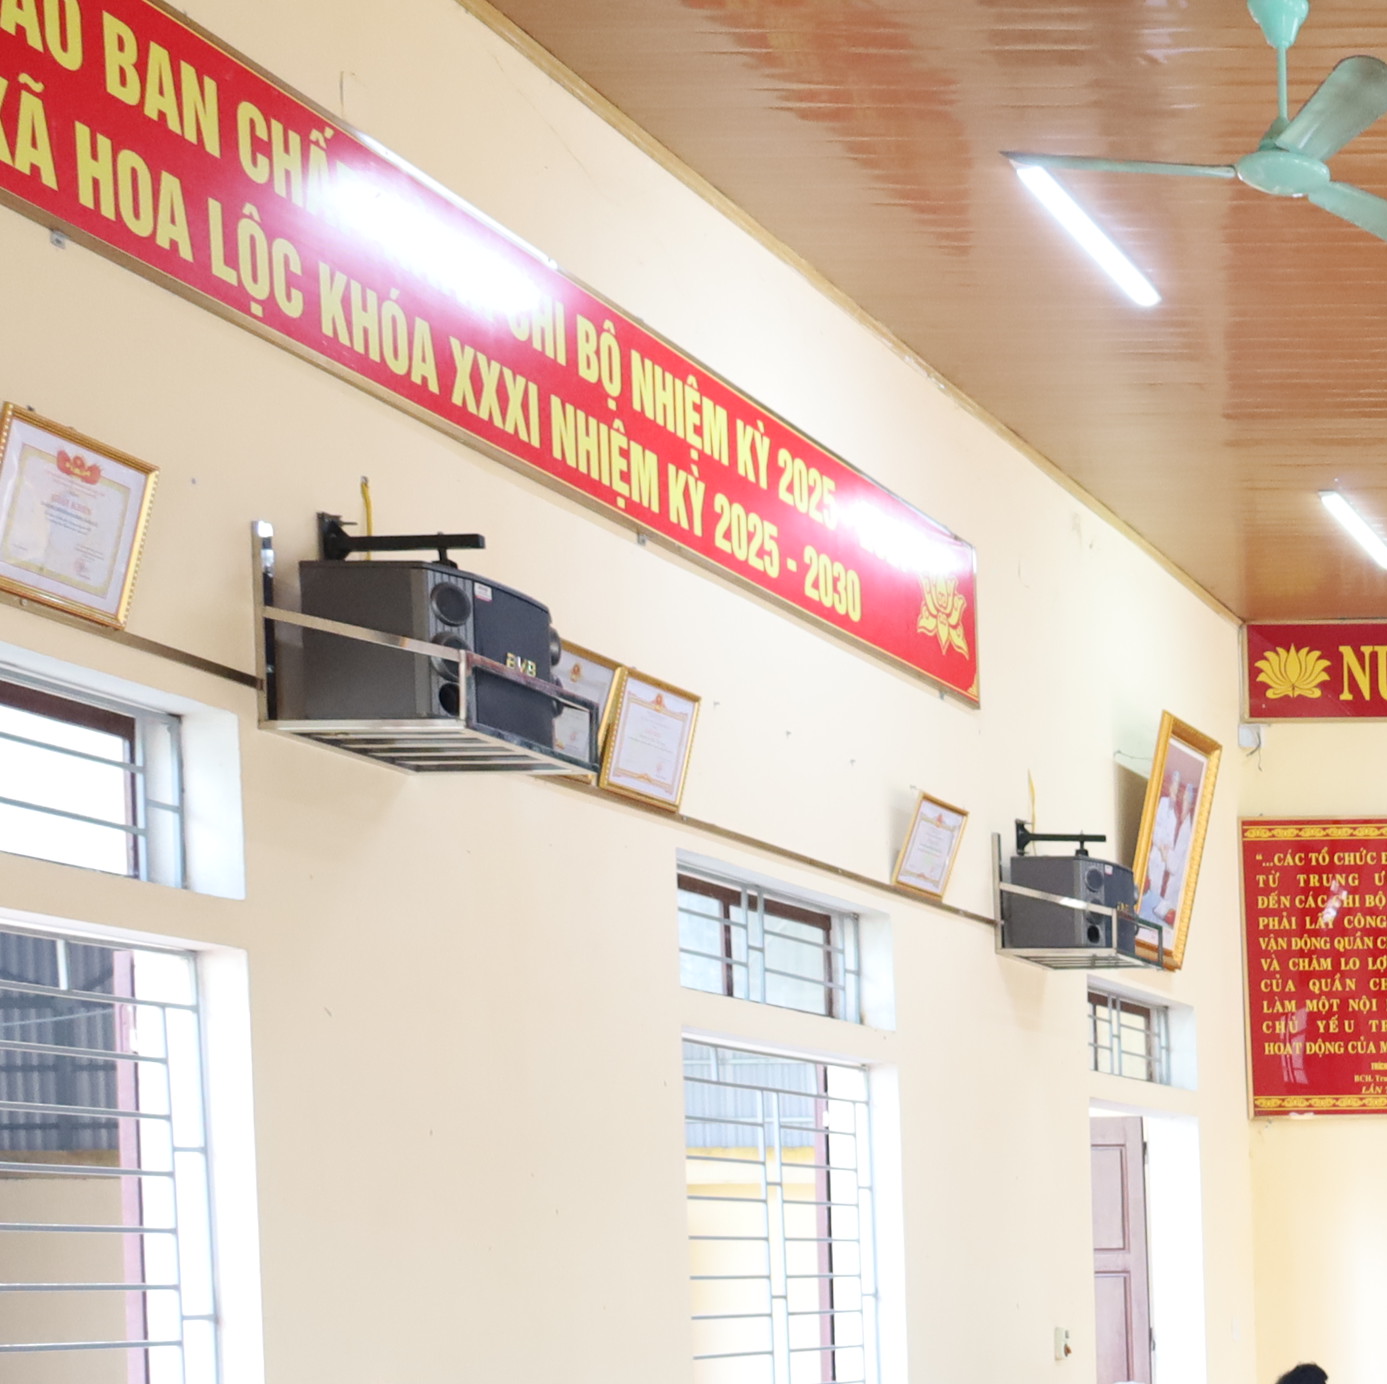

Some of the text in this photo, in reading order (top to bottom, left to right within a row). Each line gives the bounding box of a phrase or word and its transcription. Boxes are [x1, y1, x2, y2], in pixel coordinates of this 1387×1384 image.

[102, 10, 221, 159] BAN
[75, 120, 194, 263] HOA
[208, 197, 303, 319] LỘC
[318, 260, 439, 395] KHÓA
[449, 335, 541, 448] XXXI
[550, 394, 659, 514] NHIỆM
[667, 463, 706, 538] KỲ
[714, 493, 780, 579] 2025
[804, 545, 861, 623] 2030
[576, 313, 837, 531] BỘ NHIỆM KỲ 2025
[1309, 848, 1329, 864] TỔ
[1334, 848, 1376, 864] CHỨC
[1256, 871, 1279, 887] TỪ
[1296, 873, 1358, 887] TRUNG
[1258, 891, 1290, 908] ĐẾN
[1295, 892, 1326, 908] CÁC
[1365, 891, 1386, 909] BỘ
[1258, 912, 1296, 929] PHẢI
[1344, 912, 1386, 928] CÔNG
[1259, 934, 1286, 951] VẬN
[1291, 934, 1330, 951] ĐỘNG
[1334, 932, 1372, 951] QUẦN
[1260, 955, 1280, 970] VÀ
[1288, 955, 1331, 970] CHĂM
[1340, 957, 1360, 969] LO
[1260, 974, 1295, 991] CỦA
[1309, 974, 1355, 993] QUẦN
[1263, 997, 1296, 1012] LÀM
[1305, 996, 1340, 1014] MỘT
[1348, 995, 1376, 1013] NỘI
[1262, 1016, 1299, 1033] CHỦ
[1316, 1016, 1353, 1032] YẾU
[1306, 1039, 1344, 1056] ĐỘNG
[1348, 1037, 1376, 1053] CỦA
